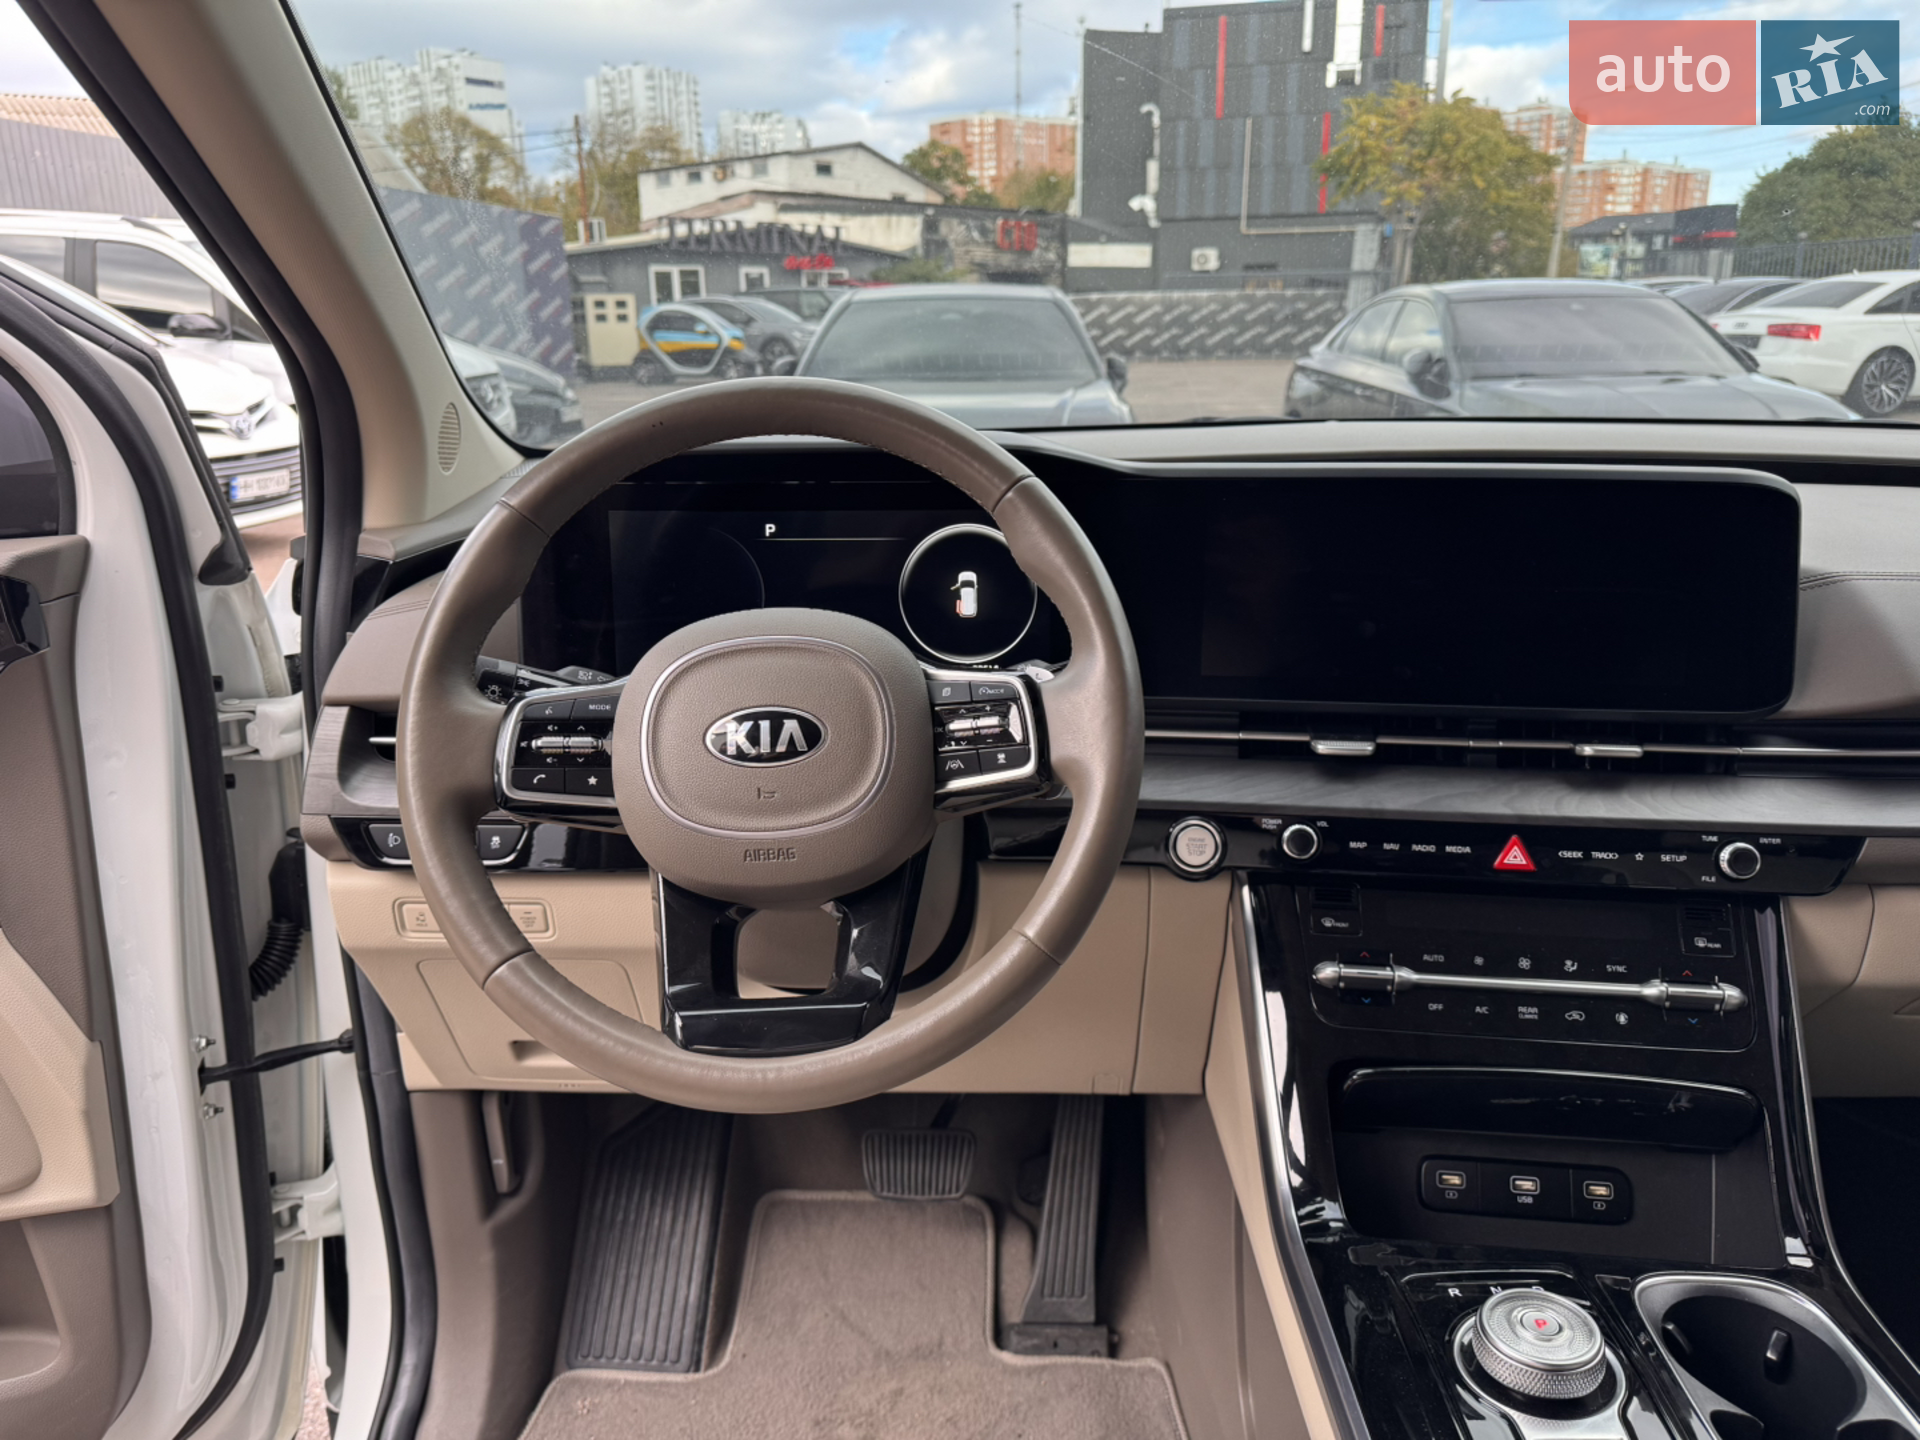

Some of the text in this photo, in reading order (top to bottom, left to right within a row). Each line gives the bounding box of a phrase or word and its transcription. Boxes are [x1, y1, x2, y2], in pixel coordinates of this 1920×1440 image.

[765, 523, 776, 537] P
[588, 703, 612, 711] MODE
[726, 719, 809, 756] KIA
[1316, 820, 1330, 828] VOL
[1349, 840, 1368, 850] MAP
[1383, 842, 1400, 851] NAV
[1411, 843, 1436, 853] RADIO
[1445, 845, 1472, 854] MEDIA
[743, 847, 797, 864] AIRBAG
[1187, 849, 1206, 857] STOP
[1660, 853, 1688, 864] SETUP
[1701, 875, 1717, 883] FILE
[1422, 954, 1445, 963] AUTO
[1606, 964, 1628, 973] SYNC
[1428, 1003, 1444, 1011] OFF
[1475, 1005, 1490, 1014] A/C
[1517, 1006, 1539, 1014] REAR
[1516, 1195, 1534, 1204] USB
[1448, 1287, 1462, 1298] R
